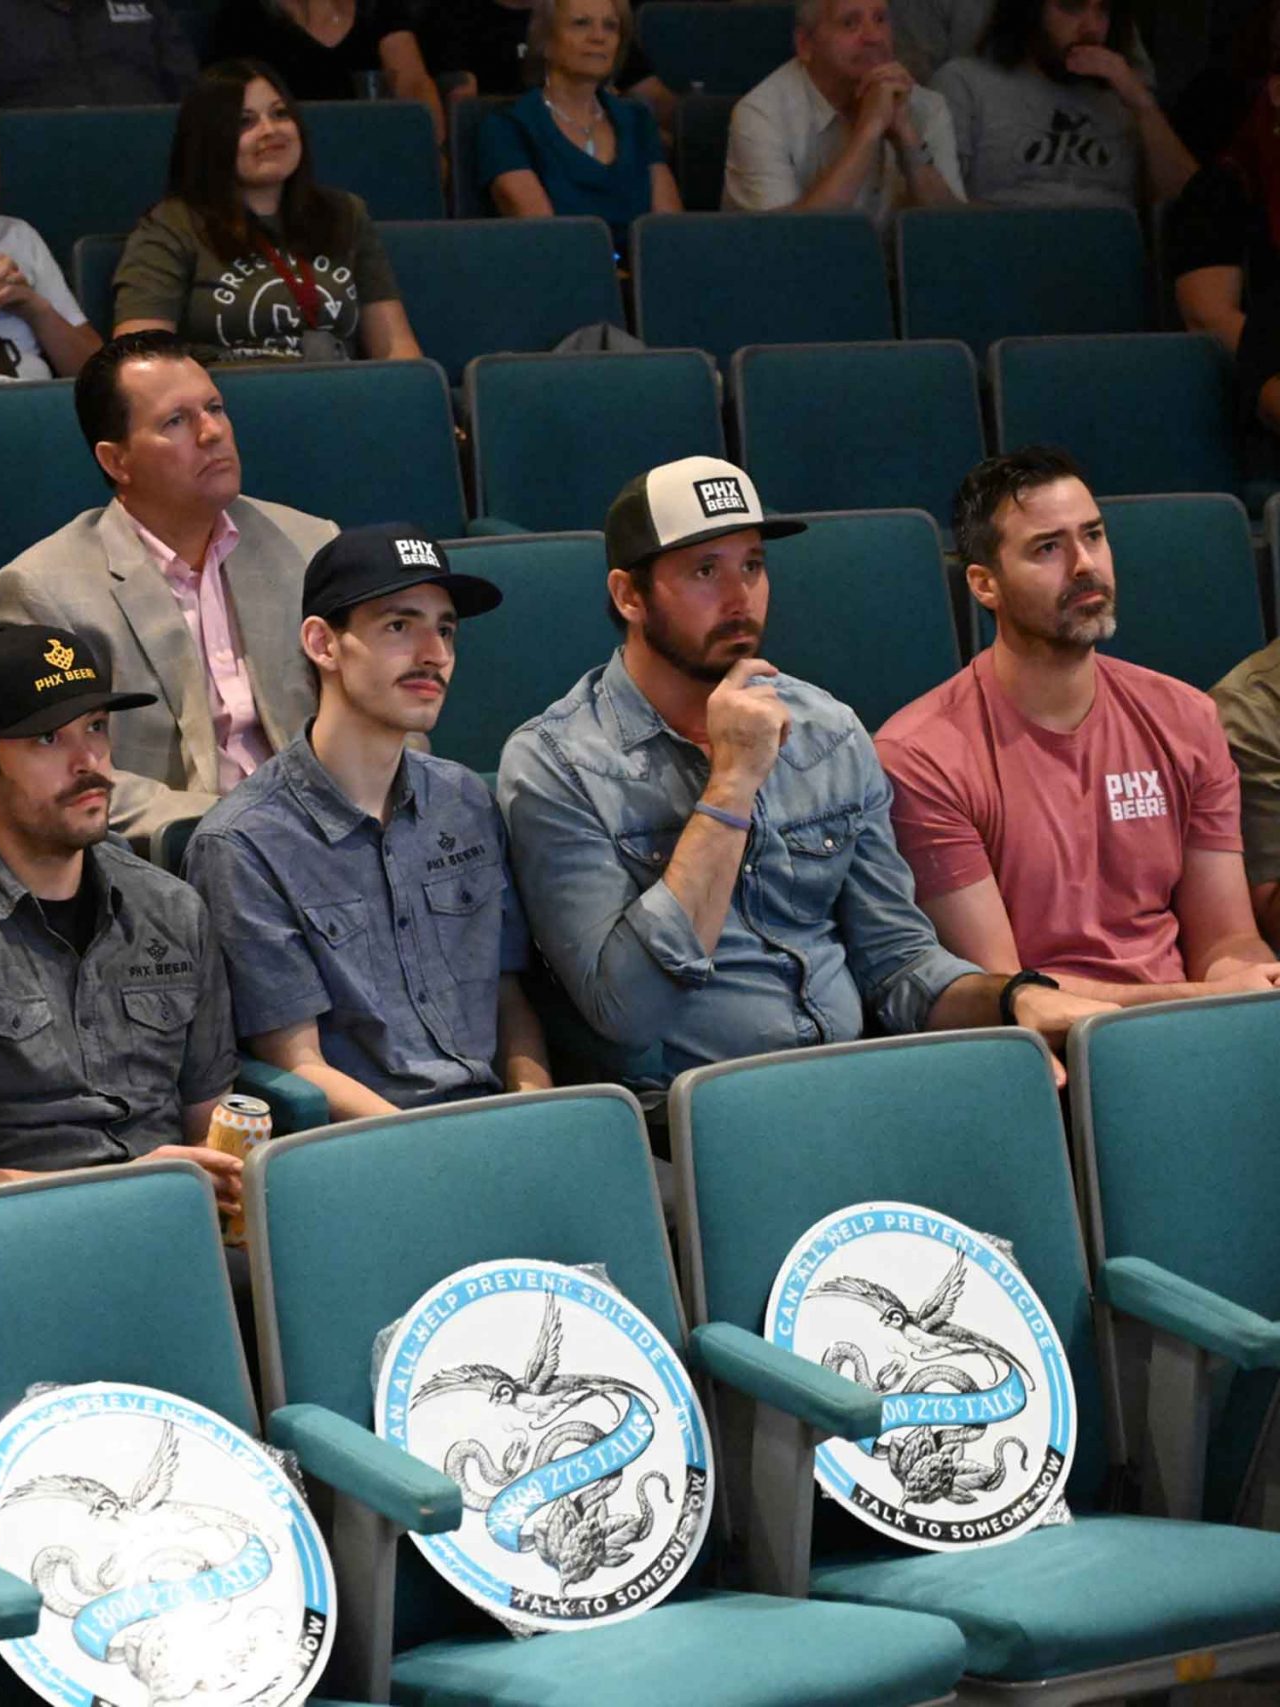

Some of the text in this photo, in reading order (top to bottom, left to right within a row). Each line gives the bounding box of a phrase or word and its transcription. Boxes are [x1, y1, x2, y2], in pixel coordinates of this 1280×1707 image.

[213, 248, 357, 306] GREOOD
[700, 481, 739, 500] PHX
[706, 497, 740, 512] BEER
[395, 539, 436, 555] PHX
[34, 672, 64, 692] PHX
[1105, 770, 1164, 801] PHX
[1110, 797, 1160, 821] BEER
[778, 1214, 1054, 1349] CAN ALL HELP PREVENT SUICIDE
[390, 1271, 664, 1450] AN ALL HELP PREVENT SUICIDE
[858, 1492, 1035, 1539] TALK TO SOMEONE
[516, 1532, 692, 1616] TALK TO SOMEONE
